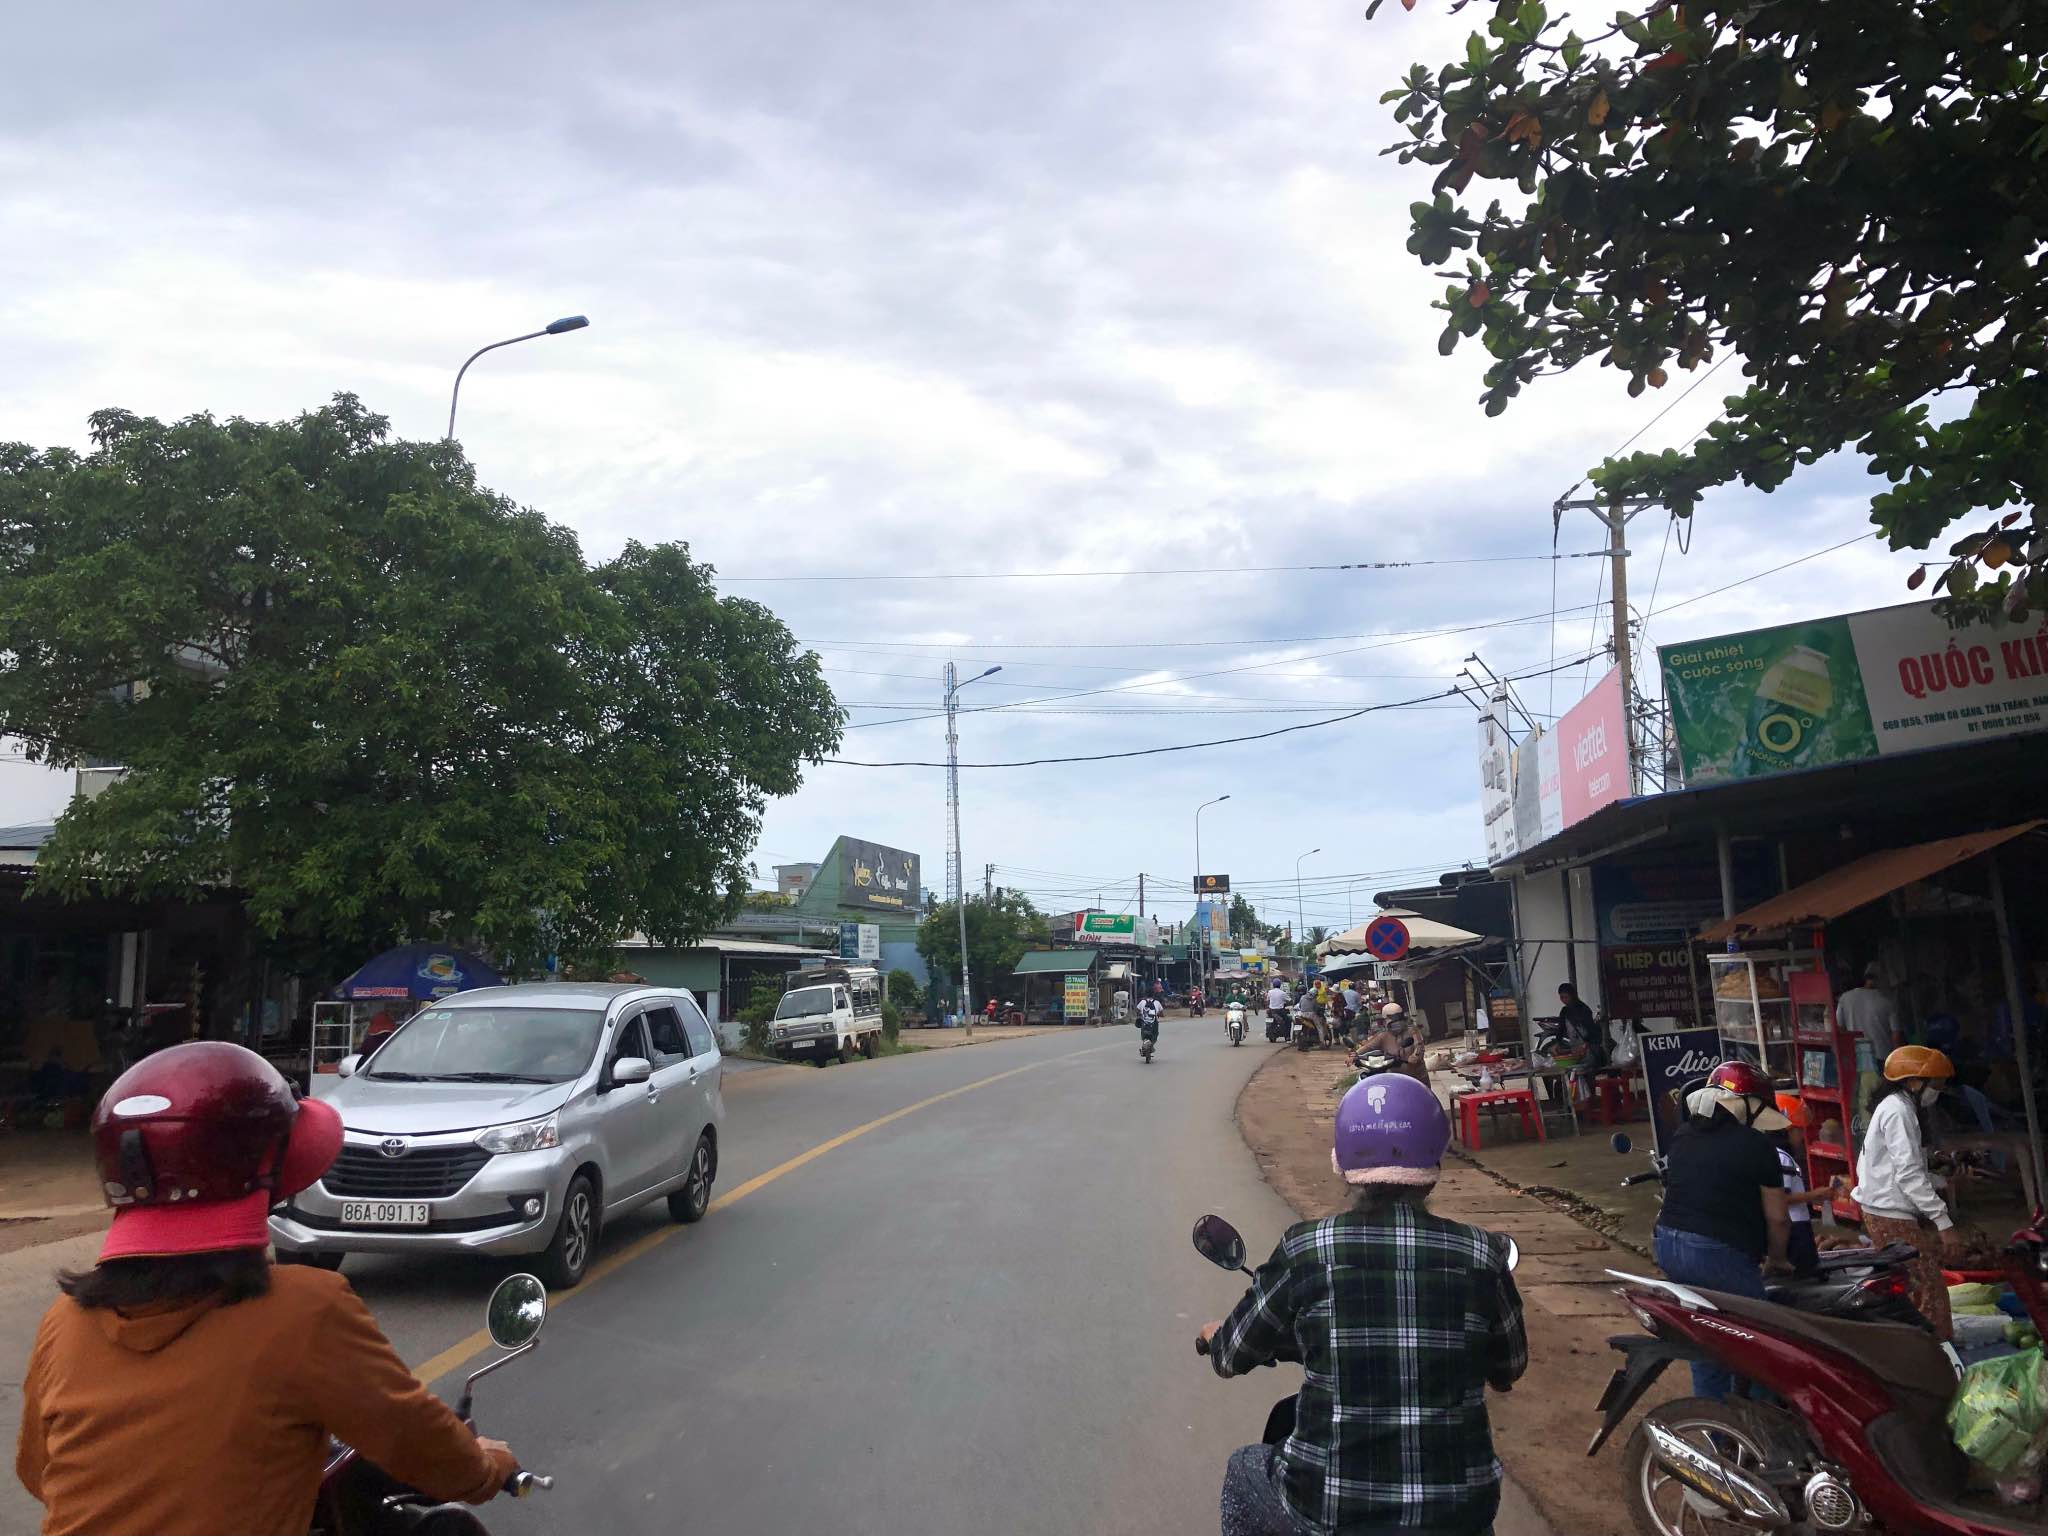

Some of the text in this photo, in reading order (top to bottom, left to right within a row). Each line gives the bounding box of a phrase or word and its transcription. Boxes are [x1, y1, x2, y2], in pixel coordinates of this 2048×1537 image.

[1897, 636, 1994, 699] QUỐC
[1573, 717, 1607, 774] viettel
[1648, 1035, 1680, 1051] KEM
[1665, 1049, 1720, 1077] Aice
[344, 1204, 426, 1222] 86A-091.13
[1690, 1314, 1756, 1340] VISION
